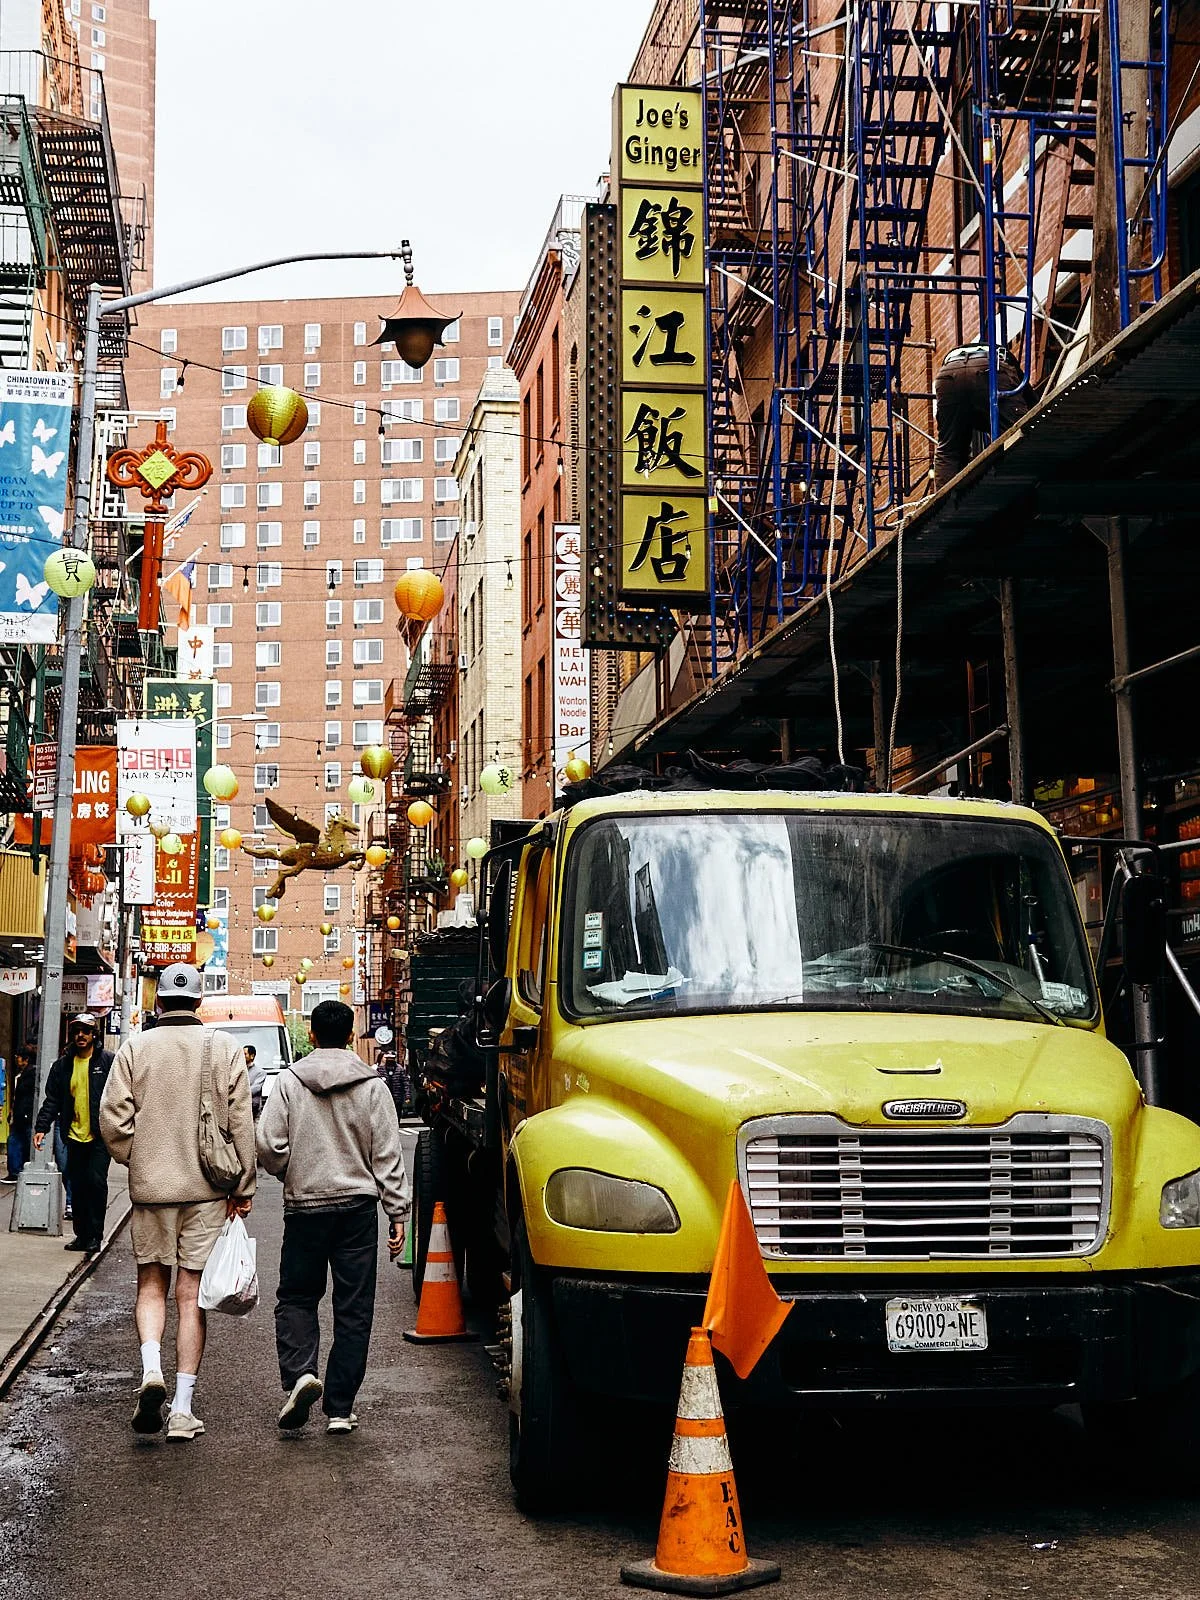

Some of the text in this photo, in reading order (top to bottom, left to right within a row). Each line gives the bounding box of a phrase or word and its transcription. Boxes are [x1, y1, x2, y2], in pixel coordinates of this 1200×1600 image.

[636, 98, 690, 128] Joe's
[625, 135, 701, 172] Ginger
[6, 375, 50, 385] CHINATOWN
[623, 196, 704, 584] 錦江飯店
[12, 489, 35, 498] CAN
[0, 501, 33, 511] UP TO
[57, 552, 88, 582] 貴
[560, 647, 585, 658] MEI
[561, 662, 584, 672] LAI
[559, 676, 587, 687] WAH
[559, 695, 588, 705] Wonton
[560, 708, 587, 717] Noodle
[559, 723, 586, 736] Bar
[36, 746, 44, 754] NO
[123, 749, 191, 771] PELL
[122, 770, 193, 780] HAIR SALON
[155, 899, 175, 907] Color
[2, 972, 28, 981] ATM
[892, 1102, 958, 1113] FREIGHTLINER
[910, 1302, 960, 1313] NEW YORK
[914, 1340, 960, 1349] COMMERCIAL
